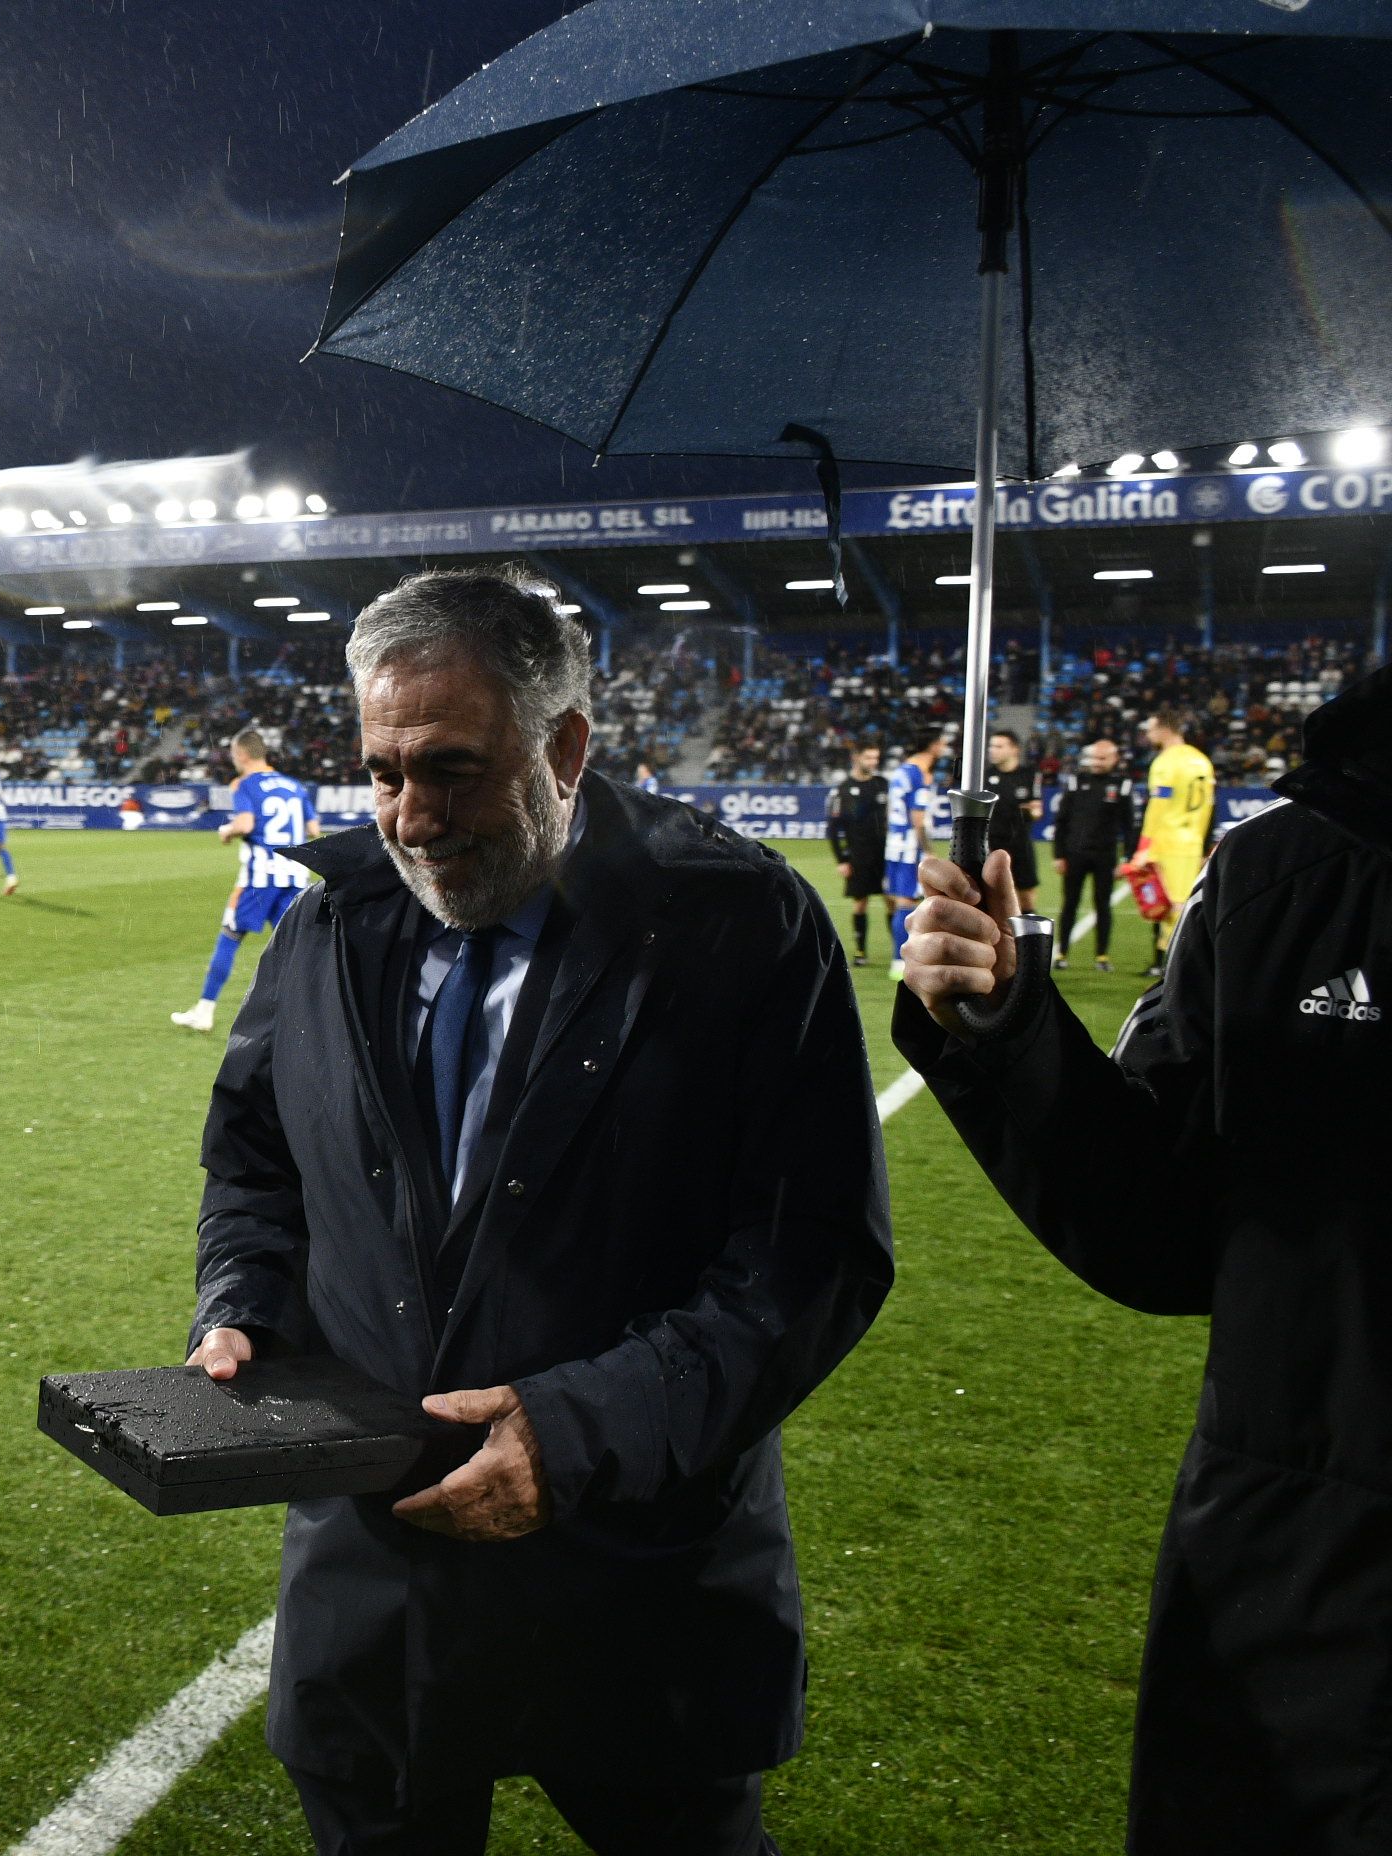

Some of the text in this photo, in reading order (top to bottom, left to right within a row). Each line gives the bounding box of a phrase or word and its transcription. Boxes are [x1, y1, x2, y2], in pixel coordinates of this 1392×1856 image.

[886, 481, 1179, 529] Estrela Galicia
[1299, 472, 1392, 511] COP
[598, 509, 646, 529] DEL
[652, 506, 696, 527] SIL
[261, 795, 306, 846] 21
[720, 789, 800, 822] gloss
[1298, 998, 1382, 1021] adidas
